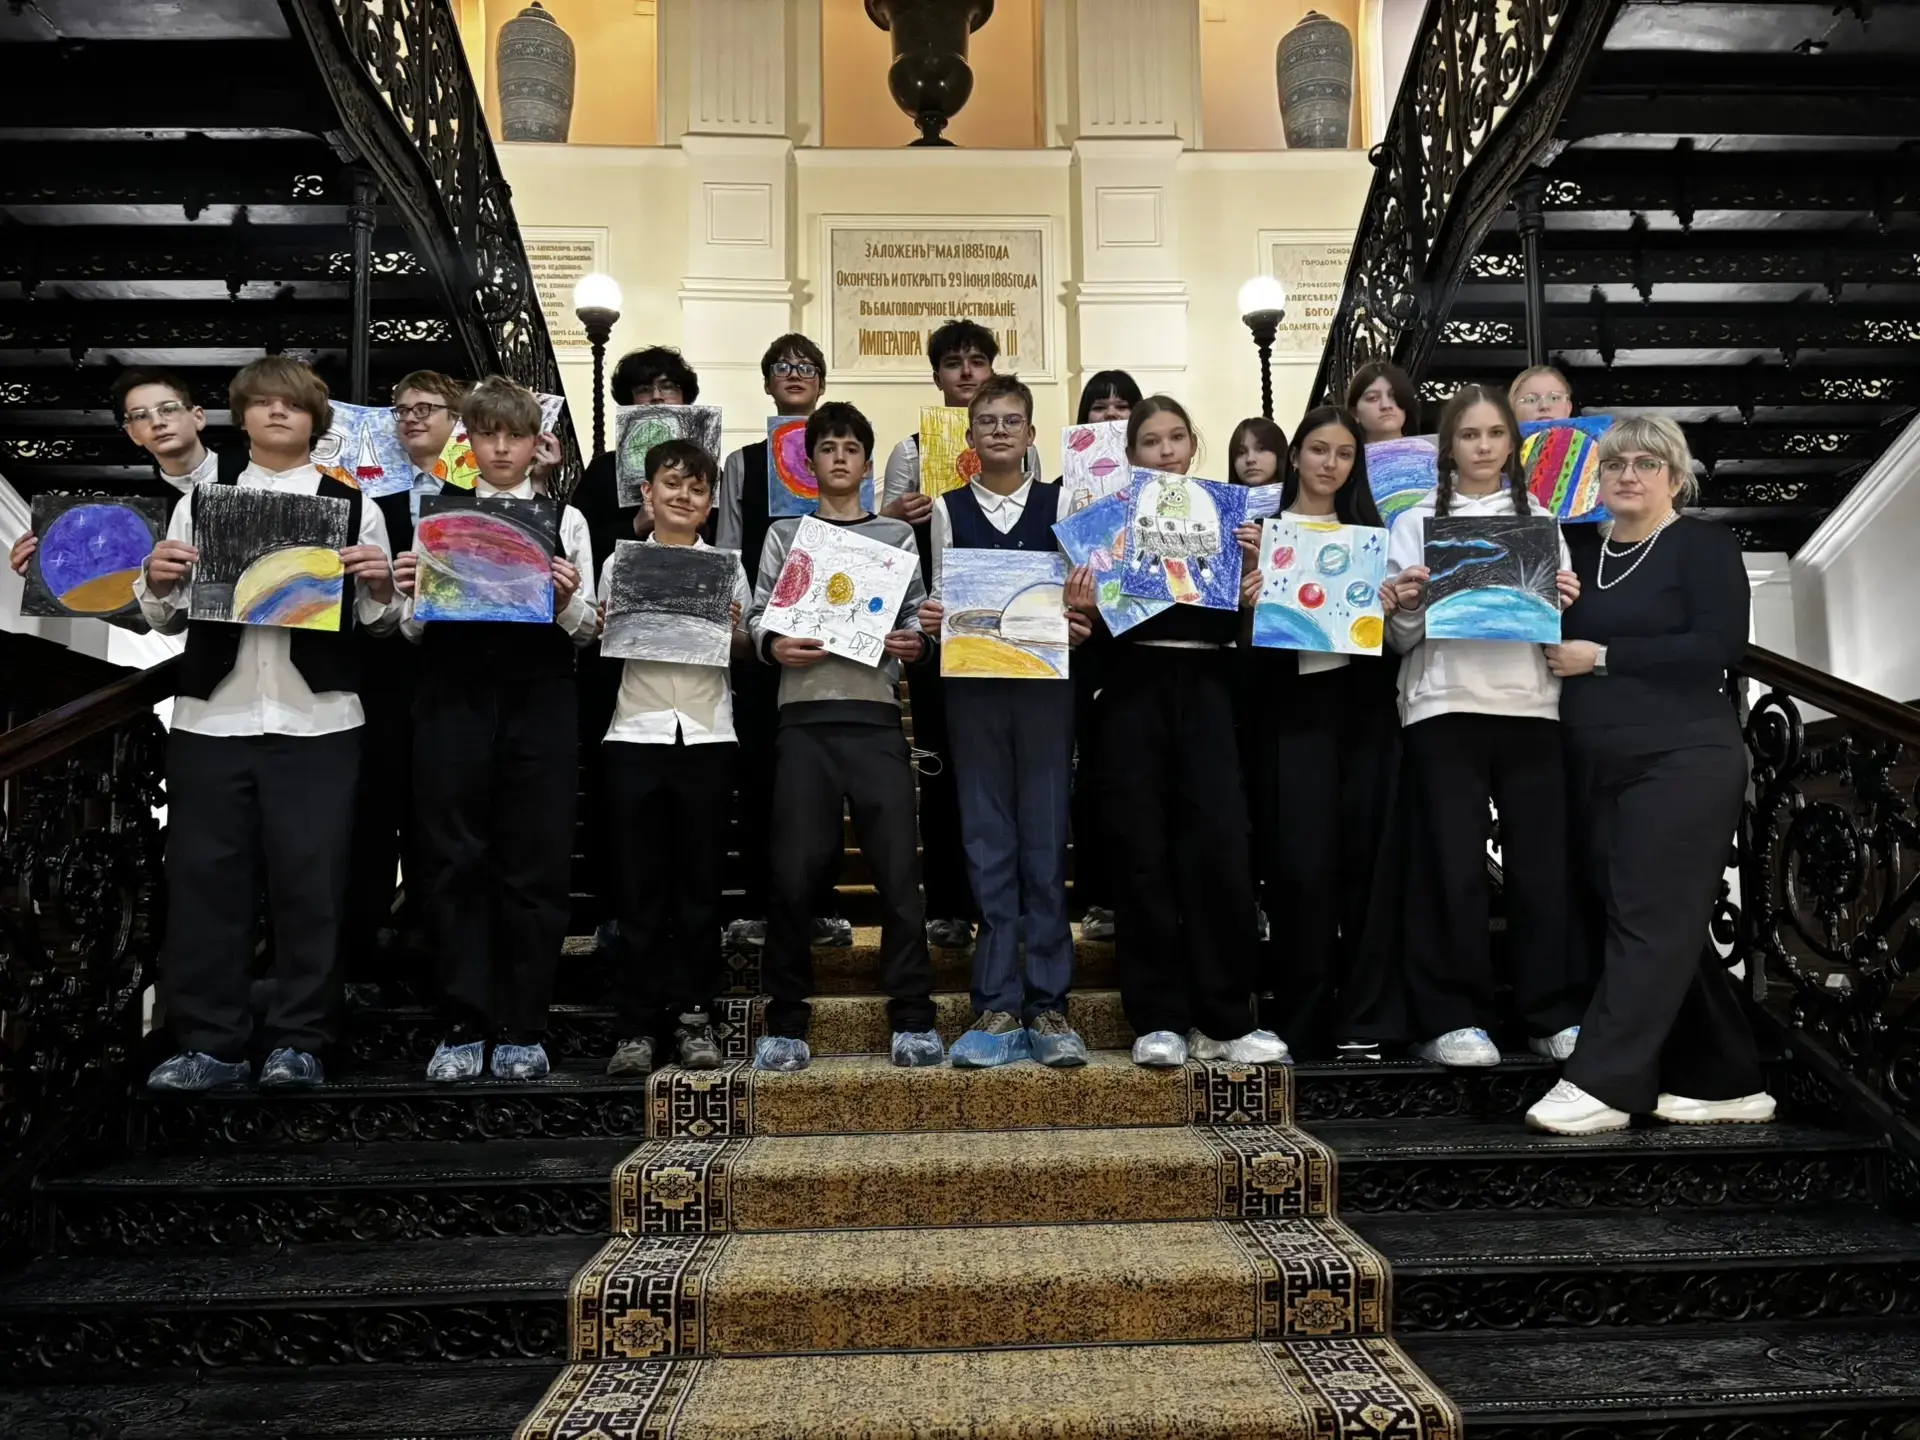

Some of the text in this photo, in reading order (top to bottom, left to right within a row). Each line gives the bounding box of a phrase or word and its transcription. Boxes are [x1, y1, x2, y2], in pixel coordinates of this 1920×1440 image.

[865, 243, 926, 259] ЗАЛОЖЕНЪ
[936, 244, 960, 259] МАЯ
[985, 244, 1009, 260] ГОДА
[892, 273, 898, 287] И
[948, 272, 961, 288] 29
[1013, 274, 1038, 290] ГОДА
[860, 300, 872, 316] ВЪ
[859, 328, 922, 356] ИМПЕРАТОРА
[1006, 329, 1018, 356] III
